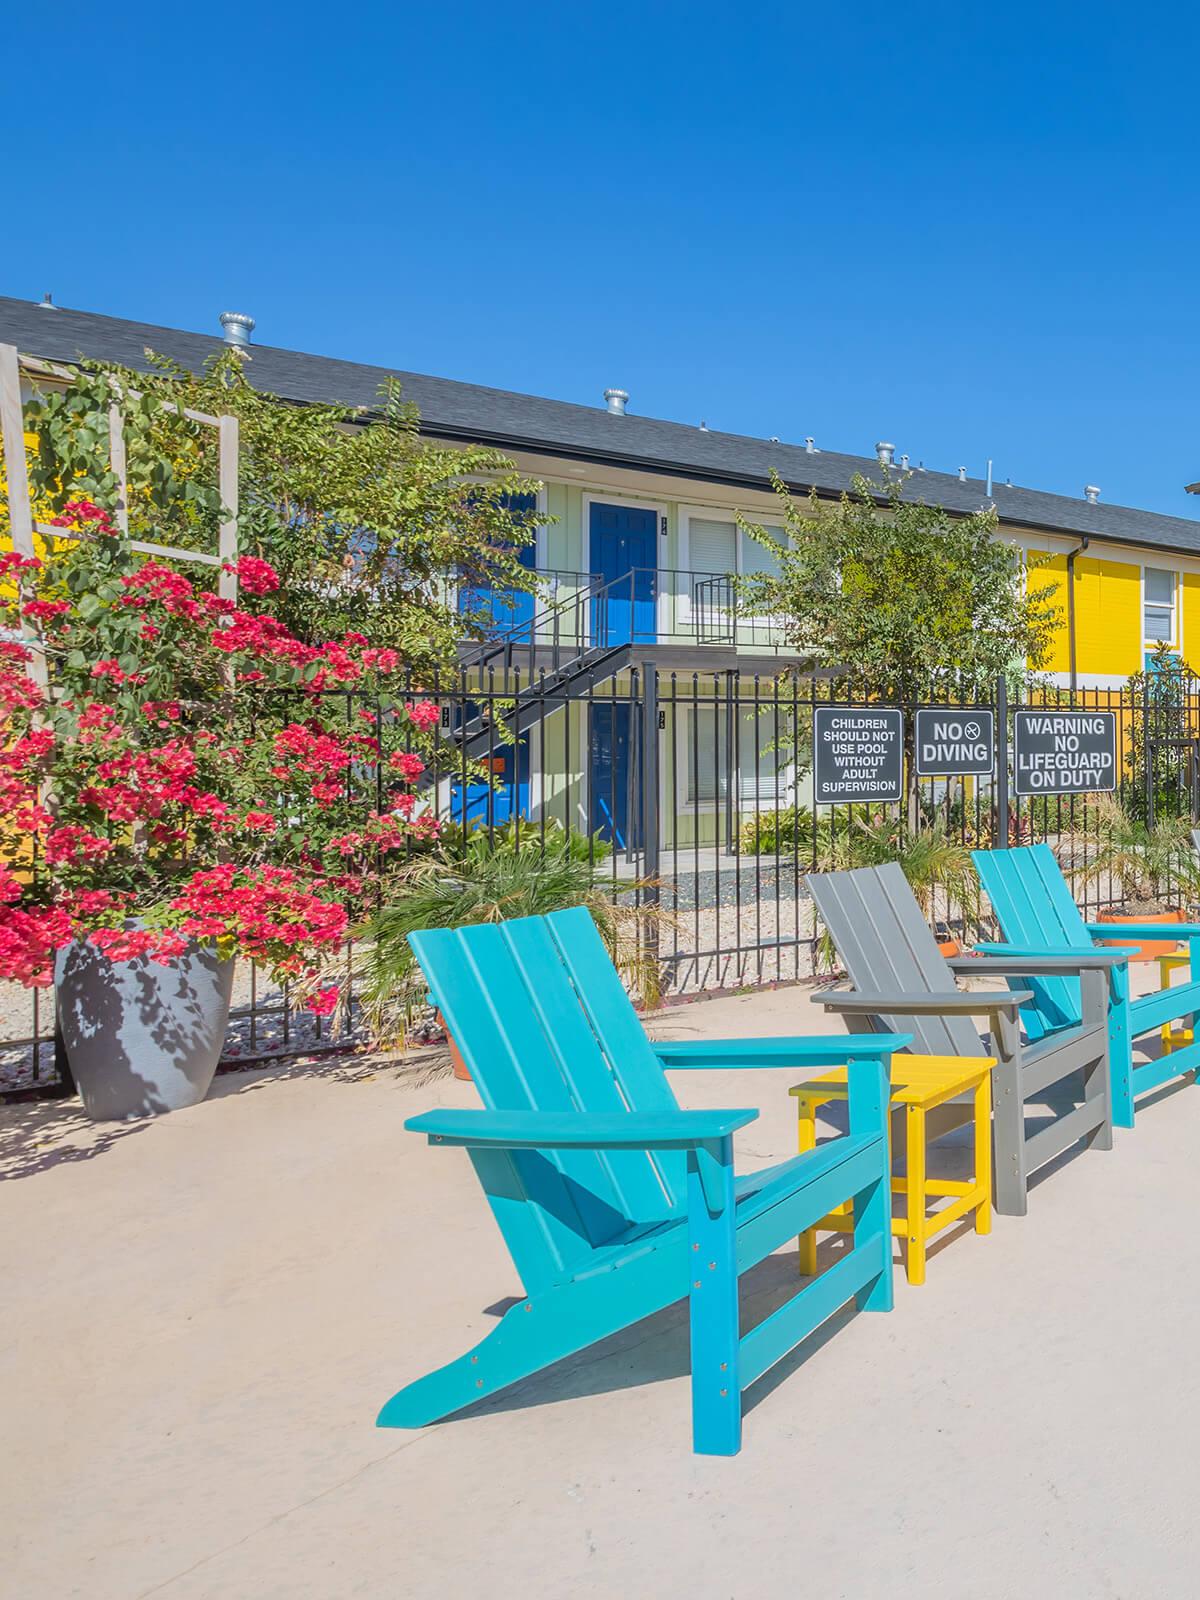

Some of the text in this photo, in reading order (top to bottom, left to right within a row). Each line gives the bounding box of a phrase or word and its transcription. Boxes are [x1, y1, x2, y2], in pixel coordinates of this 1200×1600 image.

[832, 719, 887, 728] CHILDREN
[1026, 718, 1104, 734] WARNING
[824, 731, 895, 741] SHOULD NOT
[935, 723, 962, 740] NO
[832, 744, 887, 754] USE POOL
[1055, 736, 1079, 751] NO
[924, 744, 987, 761] DIVING
[835, 756, 885, 766] WITHOUT
[1020, 753, 1111, 771] LIFEGUARD
[842, 769, 877, 779] ADULT
[1030, 770, 1102, 787] ON DUTY
[823, 781, 895, 792] SUPERVISION
